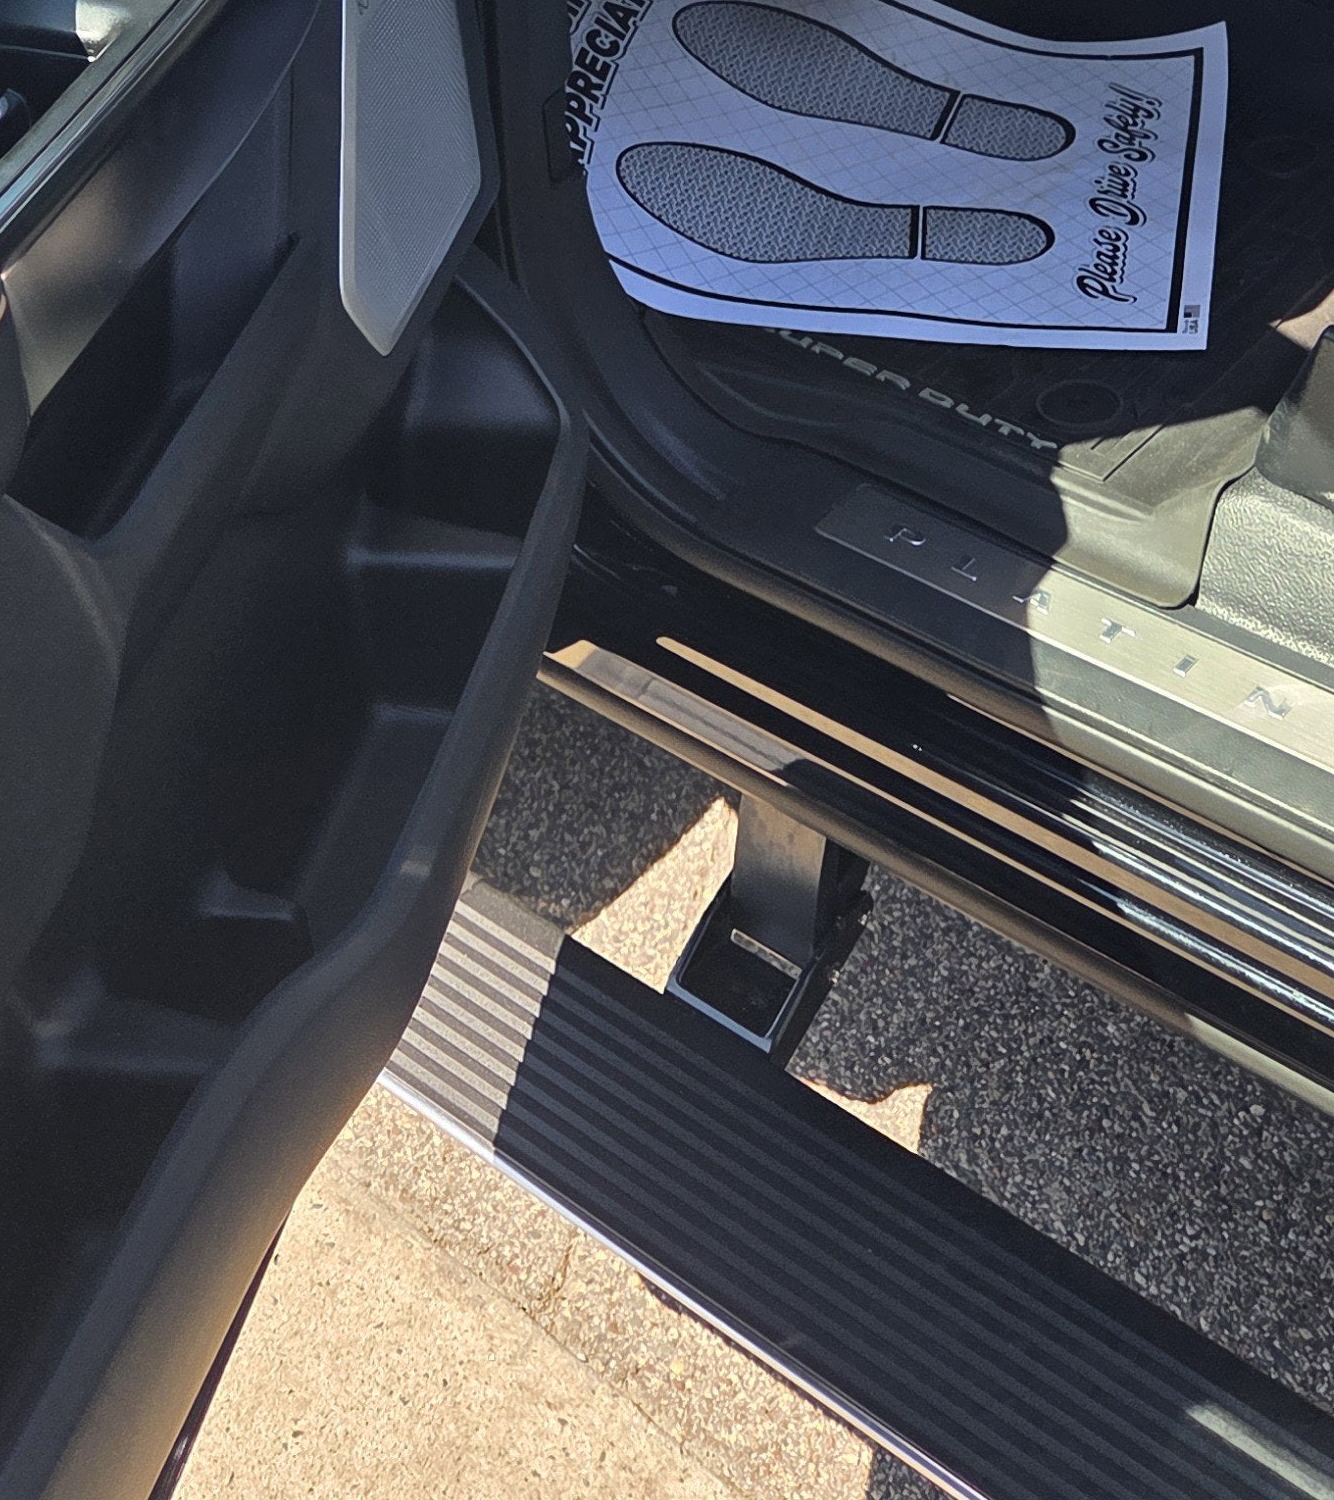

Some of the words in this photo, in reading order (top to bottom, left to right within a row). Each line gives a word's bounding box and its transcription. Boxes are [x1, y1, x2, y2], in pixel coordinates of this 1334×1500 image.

[1097, 81, 1161, 164] Safely!
[1089, 162, 1145, 227] Drive
[1076, 226, 1135, 303] Please
[765, 329, 910, 391] UPER
[918, 387, 1058, 449] DUTY
